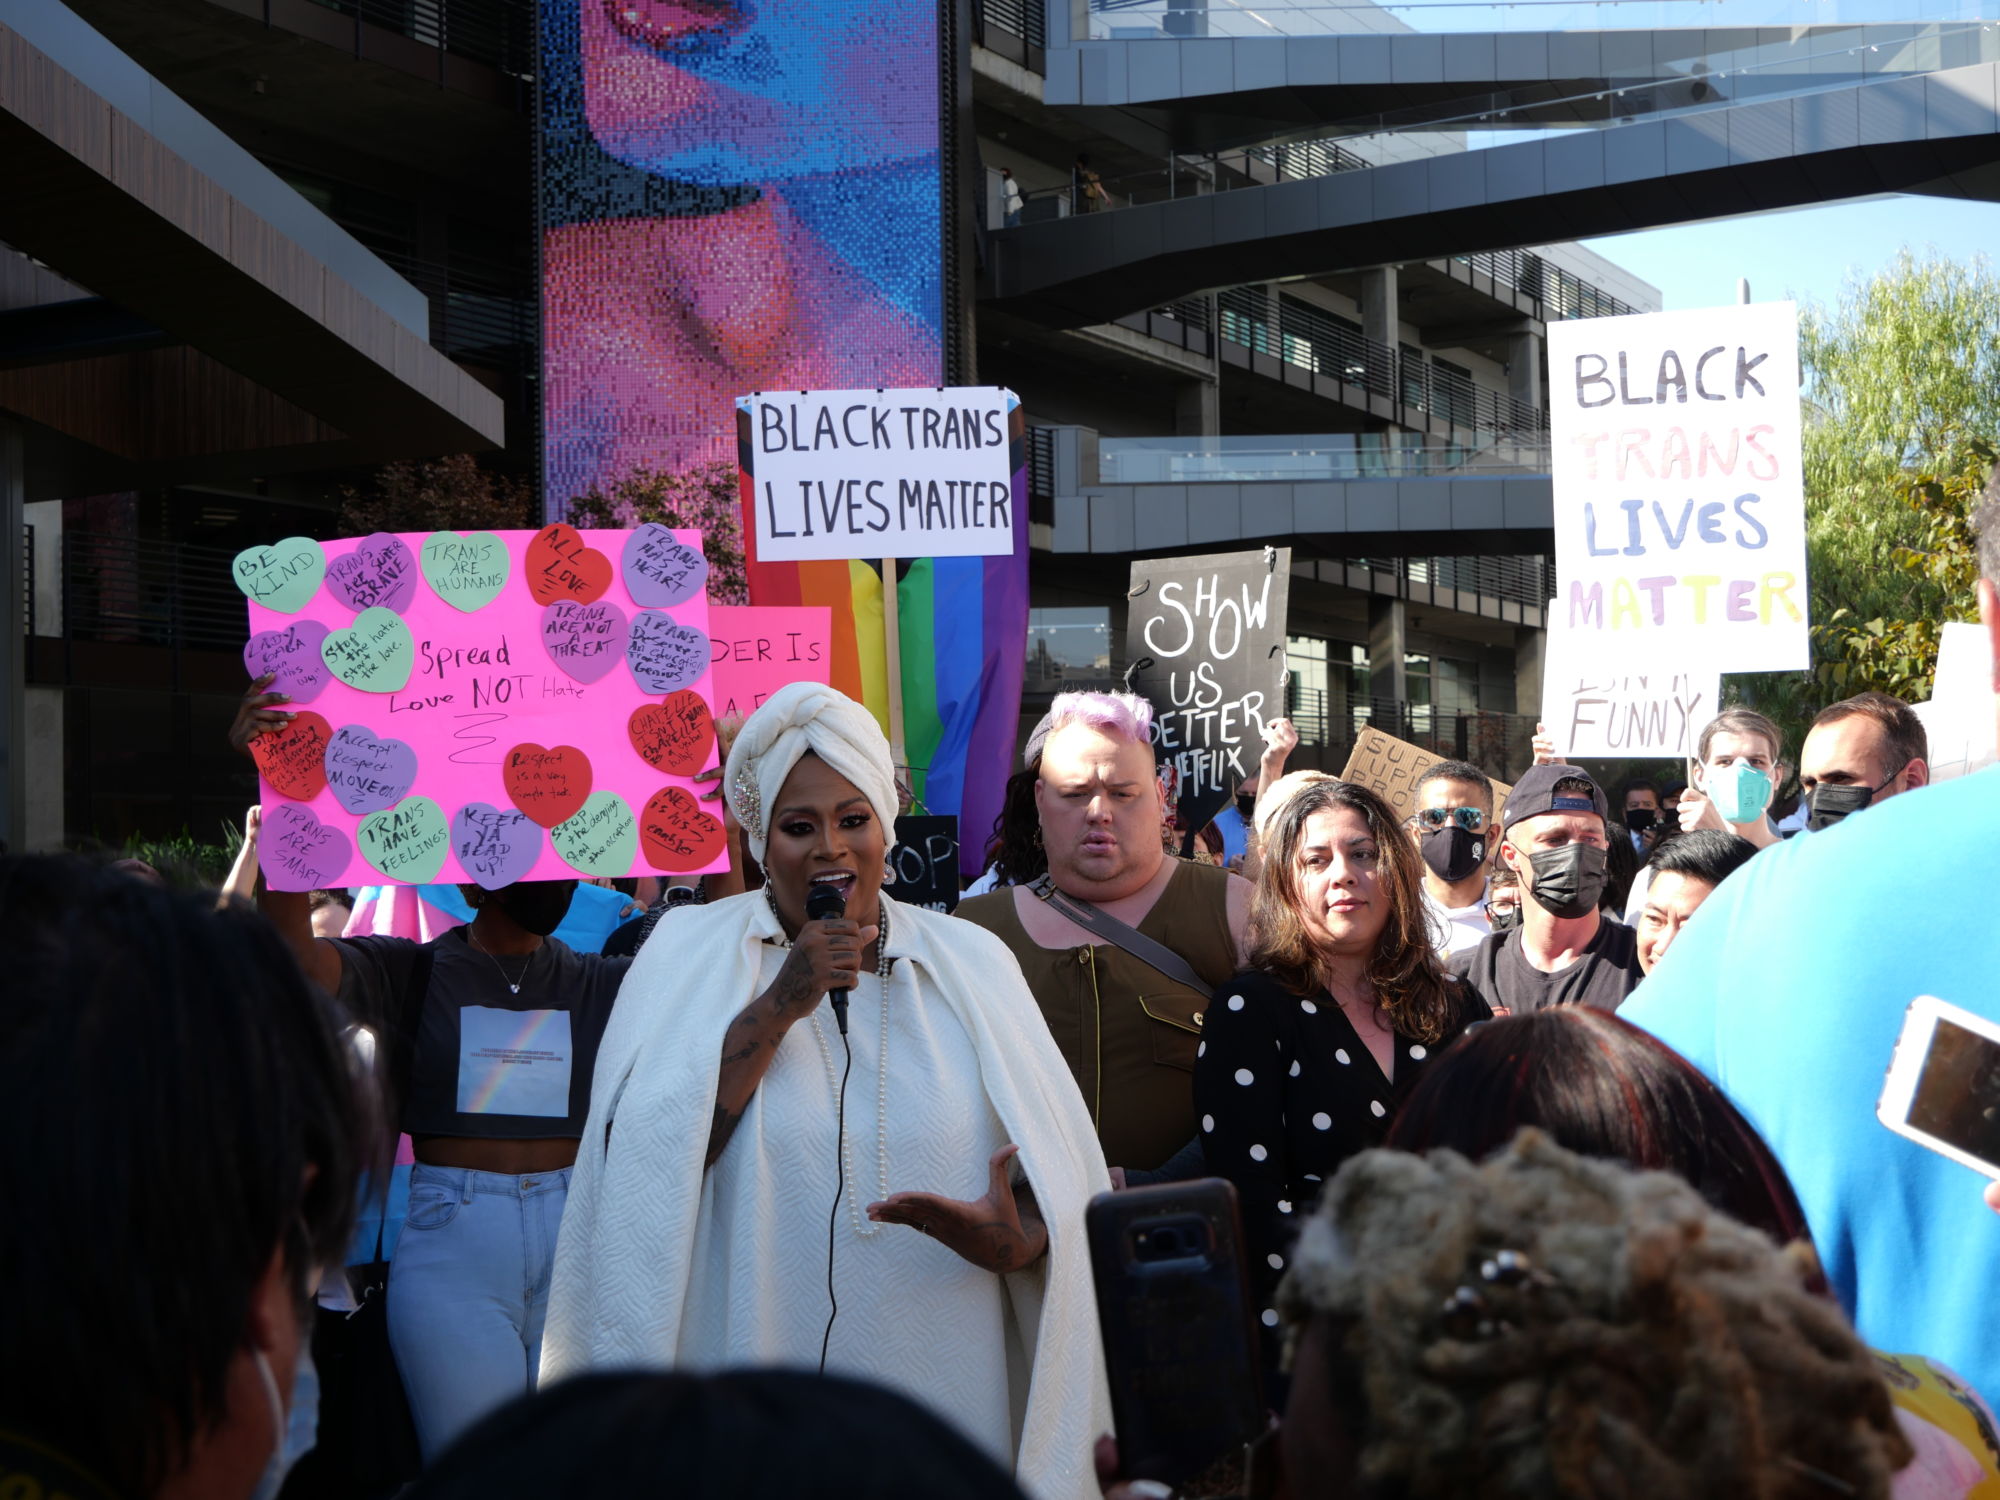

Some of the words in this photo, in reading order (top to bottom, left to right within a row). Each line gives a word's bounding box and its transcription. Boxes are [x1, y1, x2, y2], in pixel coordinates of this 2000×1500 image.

[1575, 346, 1769, 408] BLACK
[761, 403, 892, 453] BLACK
[900, 407, 1003, 450] TRANS
[1571, 424, 1779, 481] TRANS
[765, 479, 891, 538] LIVES
[899, 479, 1010, 531] MATTER
[1584, 493, 1768, 557] LIVES
[239, 549, 278, 577] BE
[325, 547, 373, 582] TRANS
[424, 543, 492, 561] TRANS
[543, 528, 583, 566] ALL
[637, 543, 673, 569] HAS
[672, 571, 688, 581] A
[645, 524, 700, 570] TRANS
[249, 552, 315, 600] KIND
[352, 556, 409, 608] BRAVE
[435, 572, 503, 592] HUMANS
[449, 561, 480, 577] ARE
[543, 560, 591, 595] LOVE
[630, 558, 687, 594] HEART
[1144, 574, 1272, 660] SHOW
[1569, 571, 1803, 630] MATTER
[546, 620, 582, 634] ARE
[582, 618, 616, 634] NOT
[569, 632, 580, 645] A
[641, 612, 698, 643] TRANS
[421, 635, 510, 679] Spread
[550, 639, 616, 658] THREAT
[390, 694, 454, 713] Love
[473, 675, 534, 708] NOT
[542, 676, 584, 699] Hate
[1170, 662, 1222, 708] US
[1568, 692, 1702, 753] FUNNY
[280, 804, 333, 845] TRANS
[360, 802, 425, 844] TRANS
[383, 823, 421, 853] HAVE
[279, 831, 315, 856] ARE
[379, 828, 448, 873] FEELINGS
[272, 850, 329, 887] SMART
